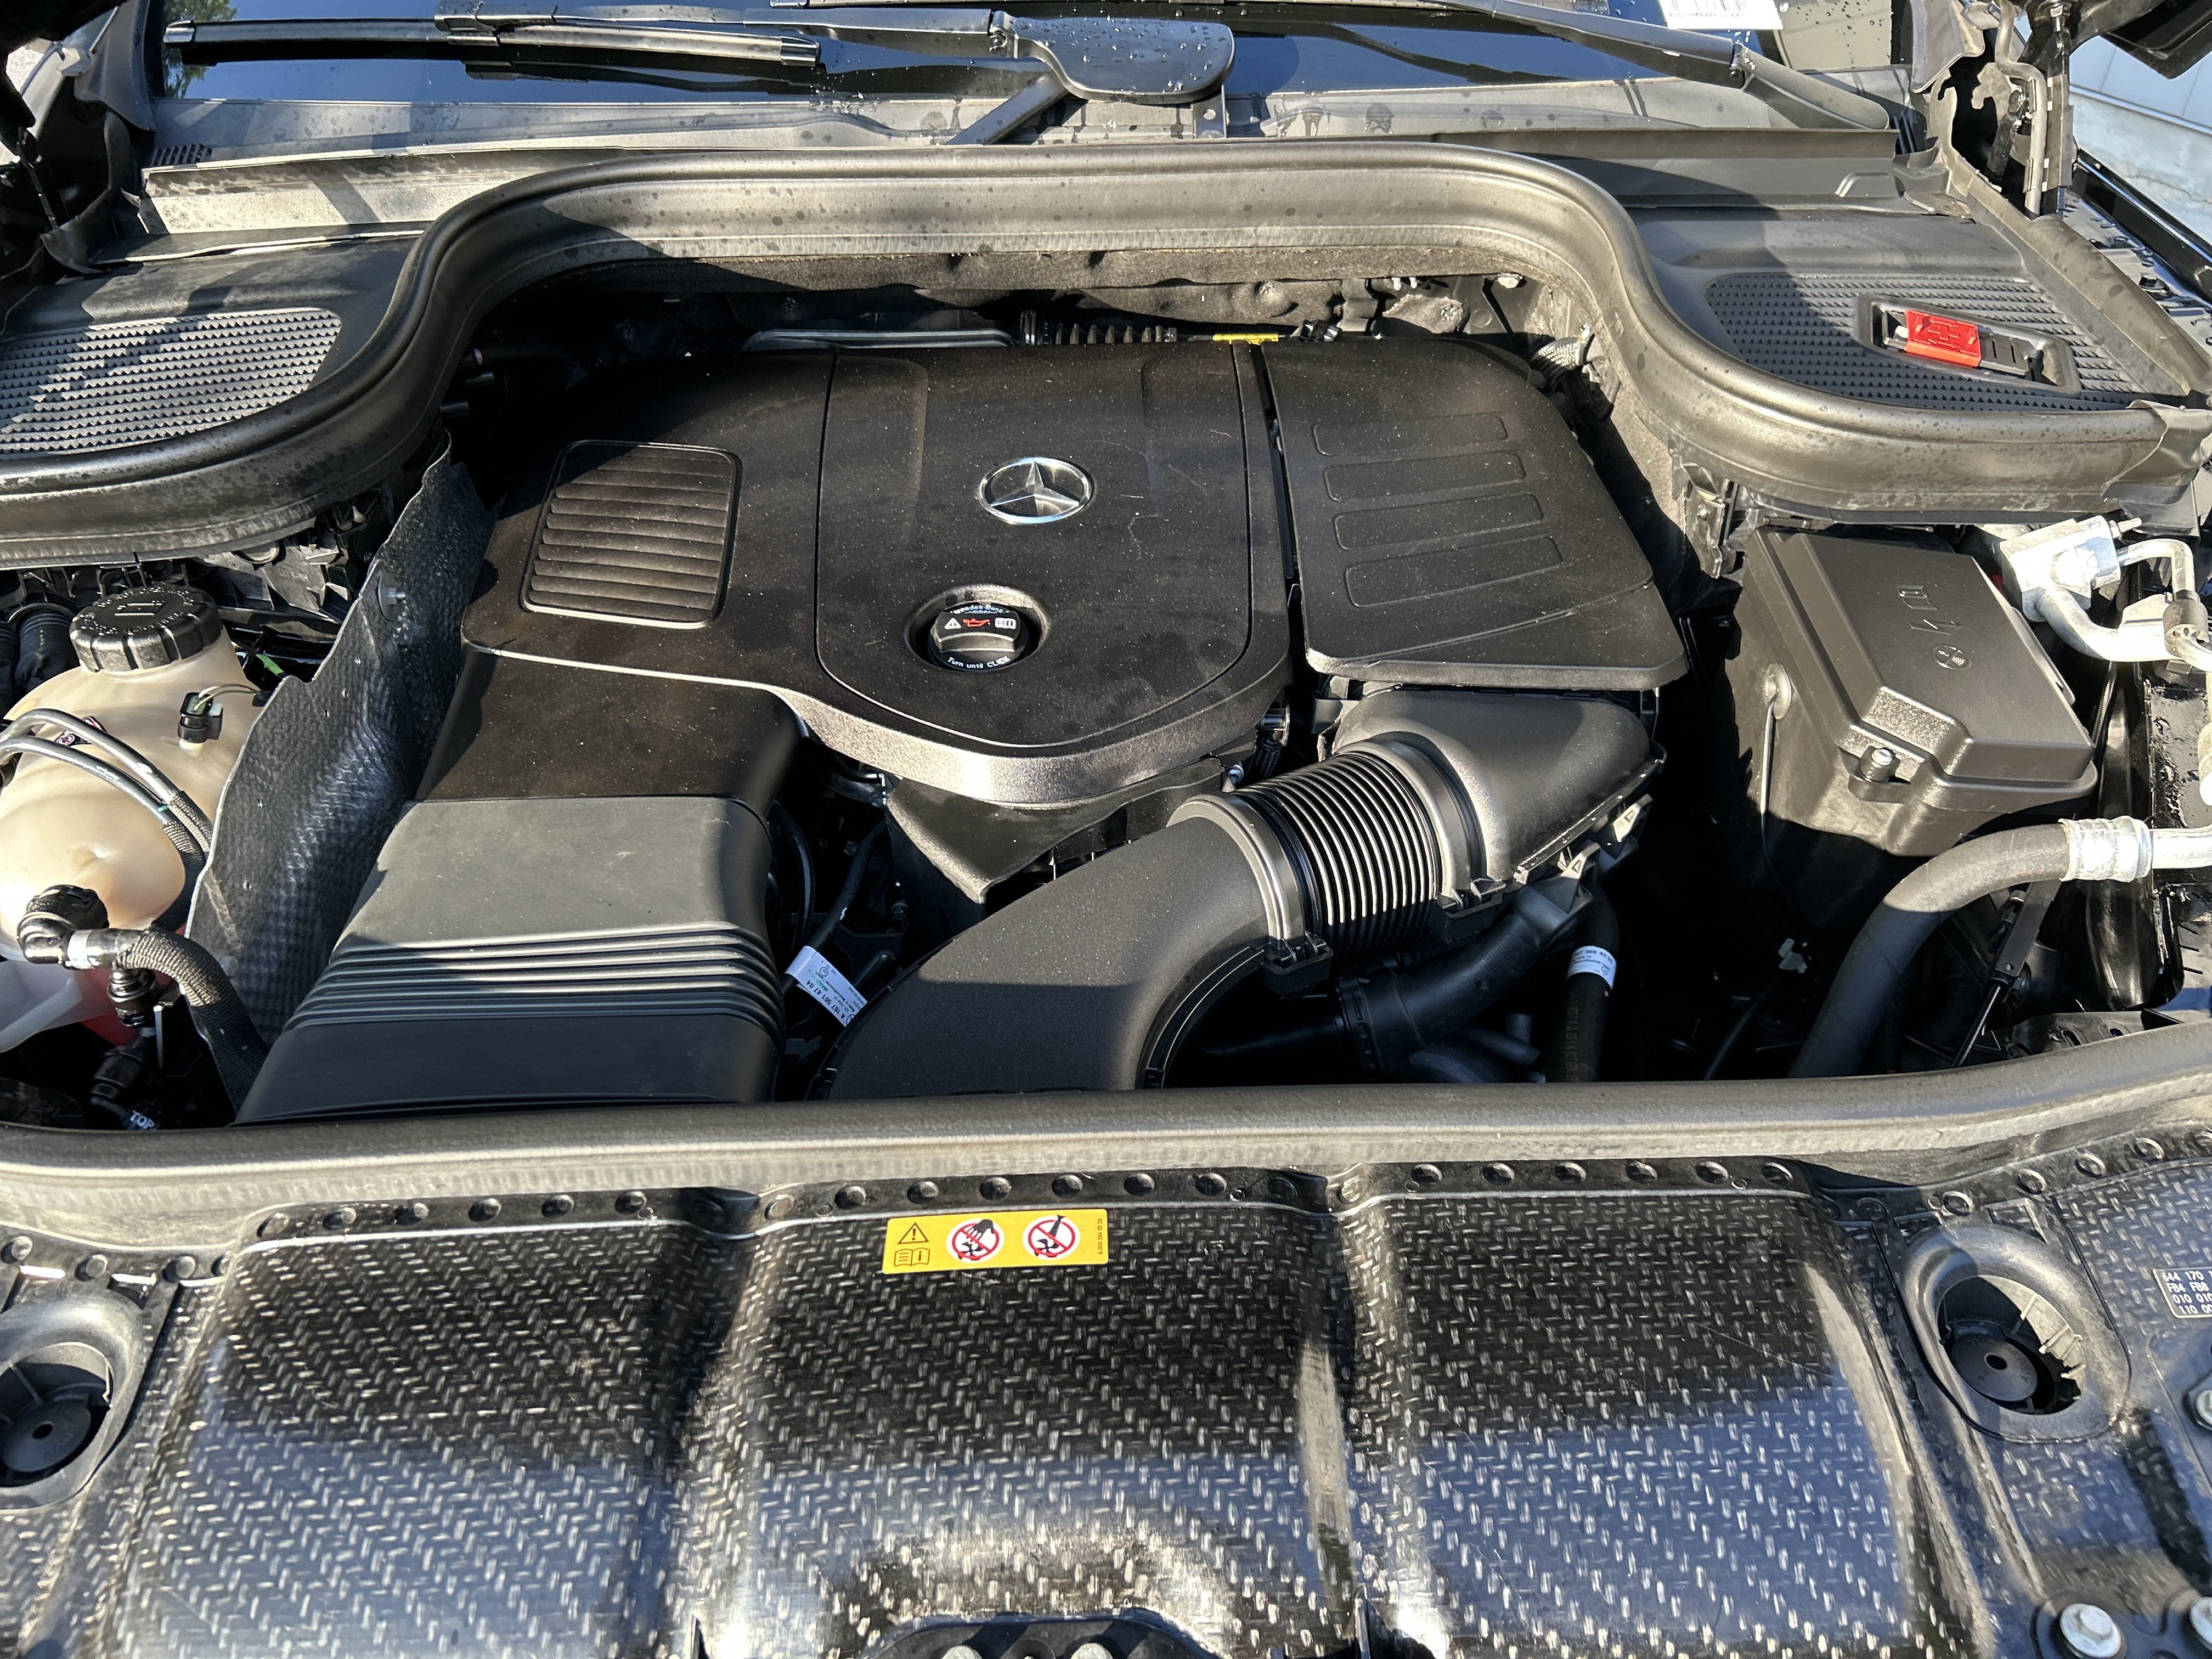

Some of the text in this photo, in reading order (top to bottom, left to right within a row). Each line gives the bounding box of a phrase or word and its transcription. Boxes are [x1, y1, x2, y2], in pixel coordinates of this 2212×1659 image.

[947, 657, 964, 667] Turn
[987, 656, 1011, 668] CLICK
[806, 980, 815, 988] 04
[821, 995, 832, 1005] 501
[831, 1004, 840, 1014] 167
[129, 1110, 155, 1129] TOP
[2162, 1272, 2181, 1282] 644
[2185, 1271, 2204, 1280] 170
[2166, 1282, 2209, 1293] FB4 FB8
[2172, 1294, 2192, 1304] 010
[2179, 1305, 2198, 1314] 110
